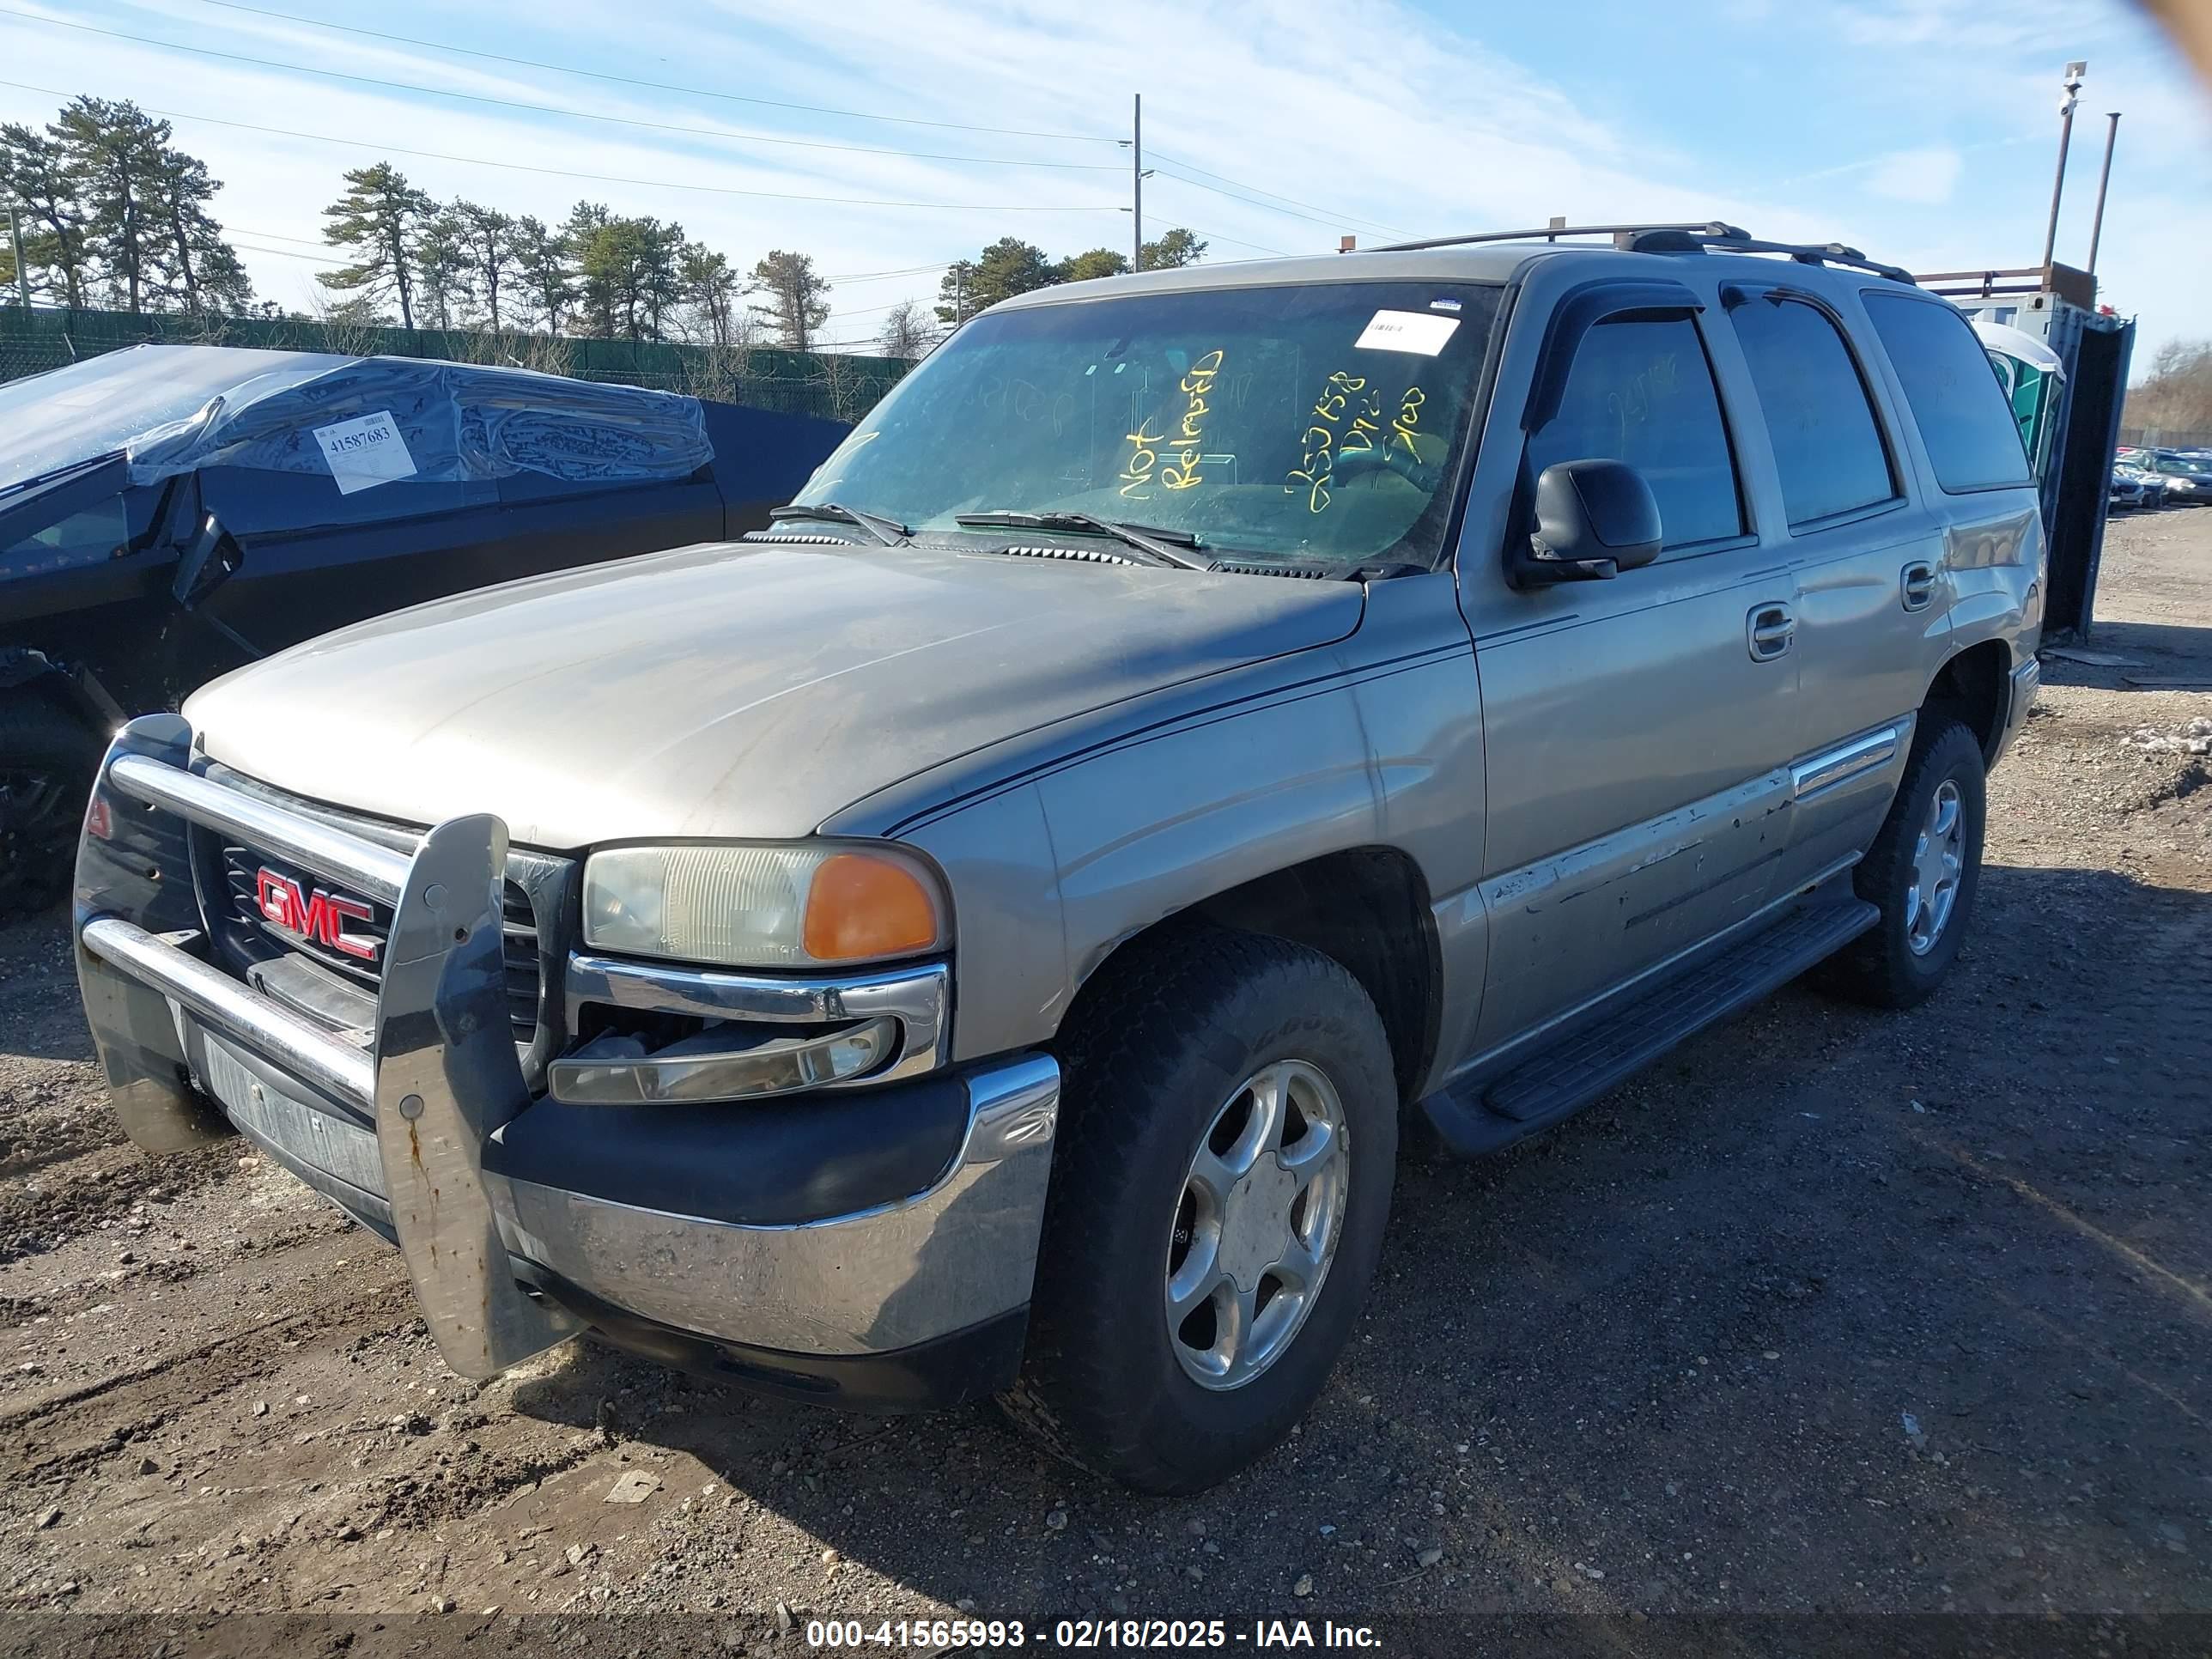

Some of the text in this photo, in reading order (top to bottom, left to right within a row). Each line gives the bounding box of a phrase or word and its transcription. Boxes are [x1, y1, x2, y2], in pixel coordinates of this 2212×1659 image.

[330, 427, 391, 453] 41587683
[1119, 416, 1164, 500] Not
[257, 865, 380, 961] GMC
